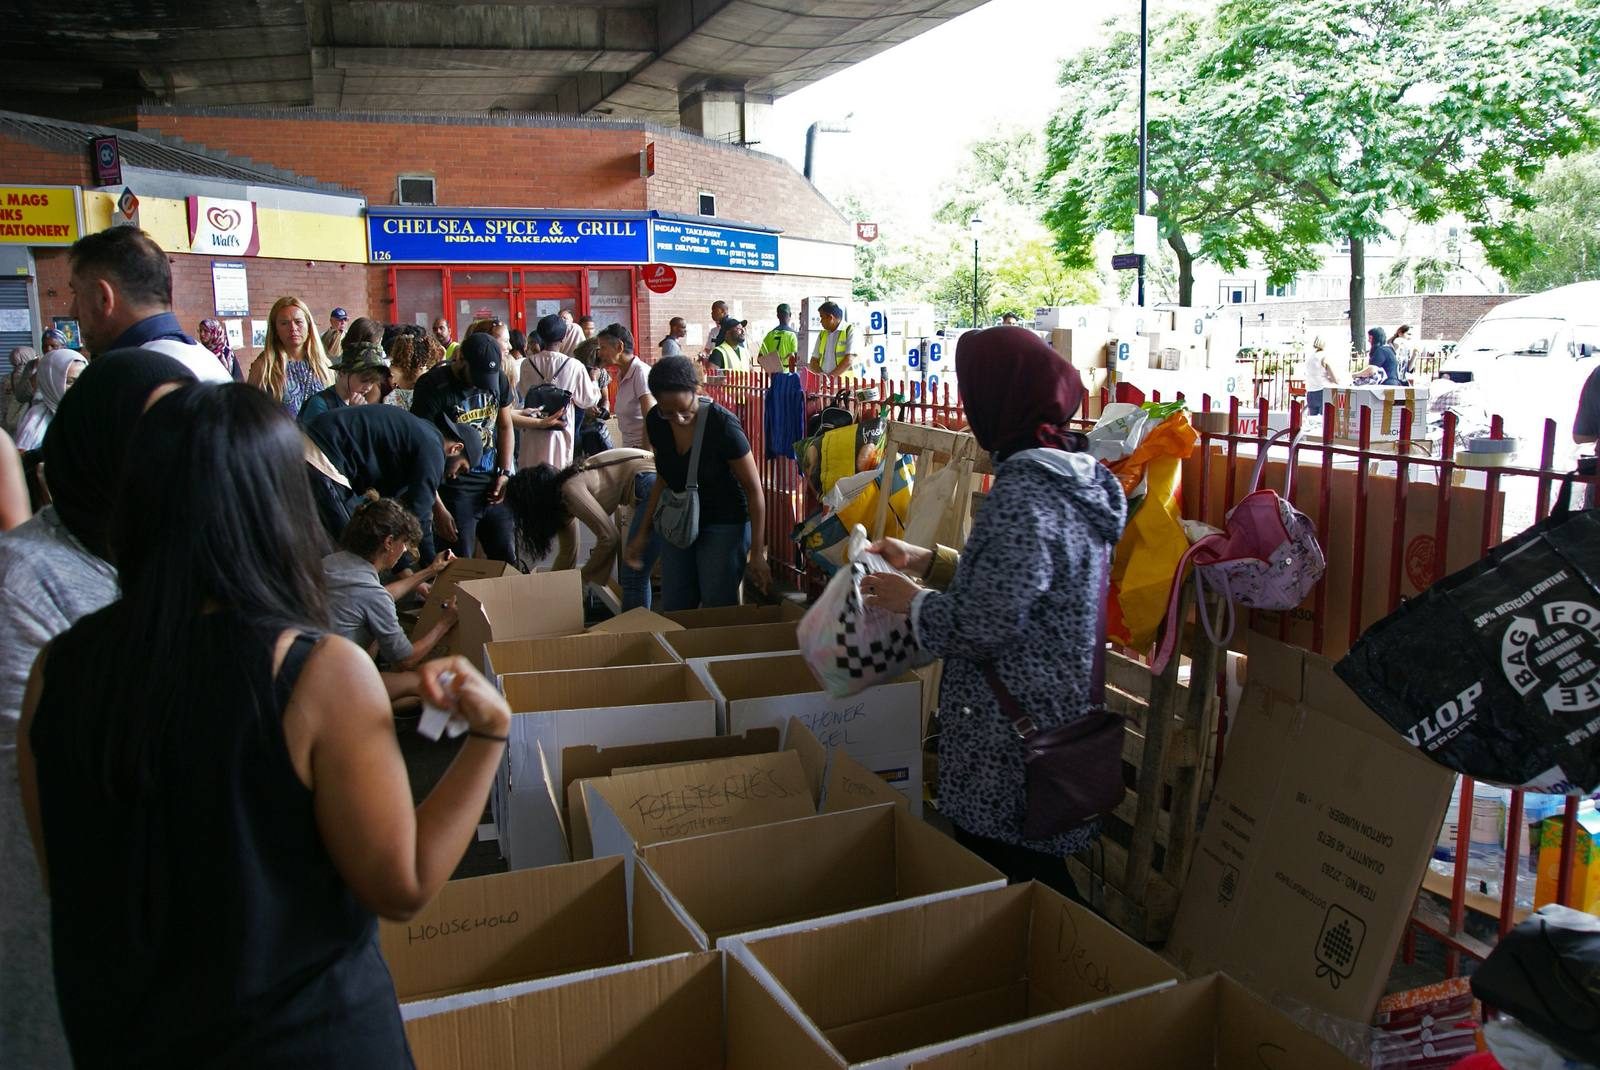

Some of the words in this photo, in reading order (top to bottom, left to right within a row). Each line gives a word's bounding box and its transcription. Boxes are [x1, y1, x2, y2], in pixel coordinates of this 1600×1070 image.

[7, 193, 49, 207] MAGS
[383, 218, 475, 235] CHELSEA
[485, 219, 538, 235] SPICE
[549, 220, 564, 235] &
[577, 221, 637, 236] GRILL
[654, 224, 682, 234] INDIAN
[685, 227, 721, 238] TAKEAWAY
[212, 233, 240, 248] Wall's
[444, 235, 497, 243] INDIAN
[505, 235, 580, 244] TAKEAWAY
[656, 242, 673, 251] FREE
[675, 244, 710, 254] DELIVERIES
[680, 235, 700, 244] OPEN
[703, 237, 708, 245] 7
[710, 239, 728, 247] DAYS
[739, 242, 757, 250] WEEK
[373, 250, 391, 261] 126
[773, 336, 782, 350] 7
[1474, 610, 1497, 628] 30%
[1494, 590, 1535, 616] RECYCLED
[1531, 569, 1569, 596] CONTENT
[1534, 636, 1555, 652] SAVE
[1553, 628, 1570, 641] THE
[1507, 629, 1537, 688] BAG
[1535, 633, 1586, 667] ENVIRONMENT
[1559, 667, 1581, 684] THIS
[1577, 659, 1597, 675] BAG
[1427, 713, 1479, 752] SPORT
[1360, 822, 1393, 848] CARTON
[1357, 882, 1377, 902] ITEM
[407, 911, 520, 945] HOUSEHOLD
